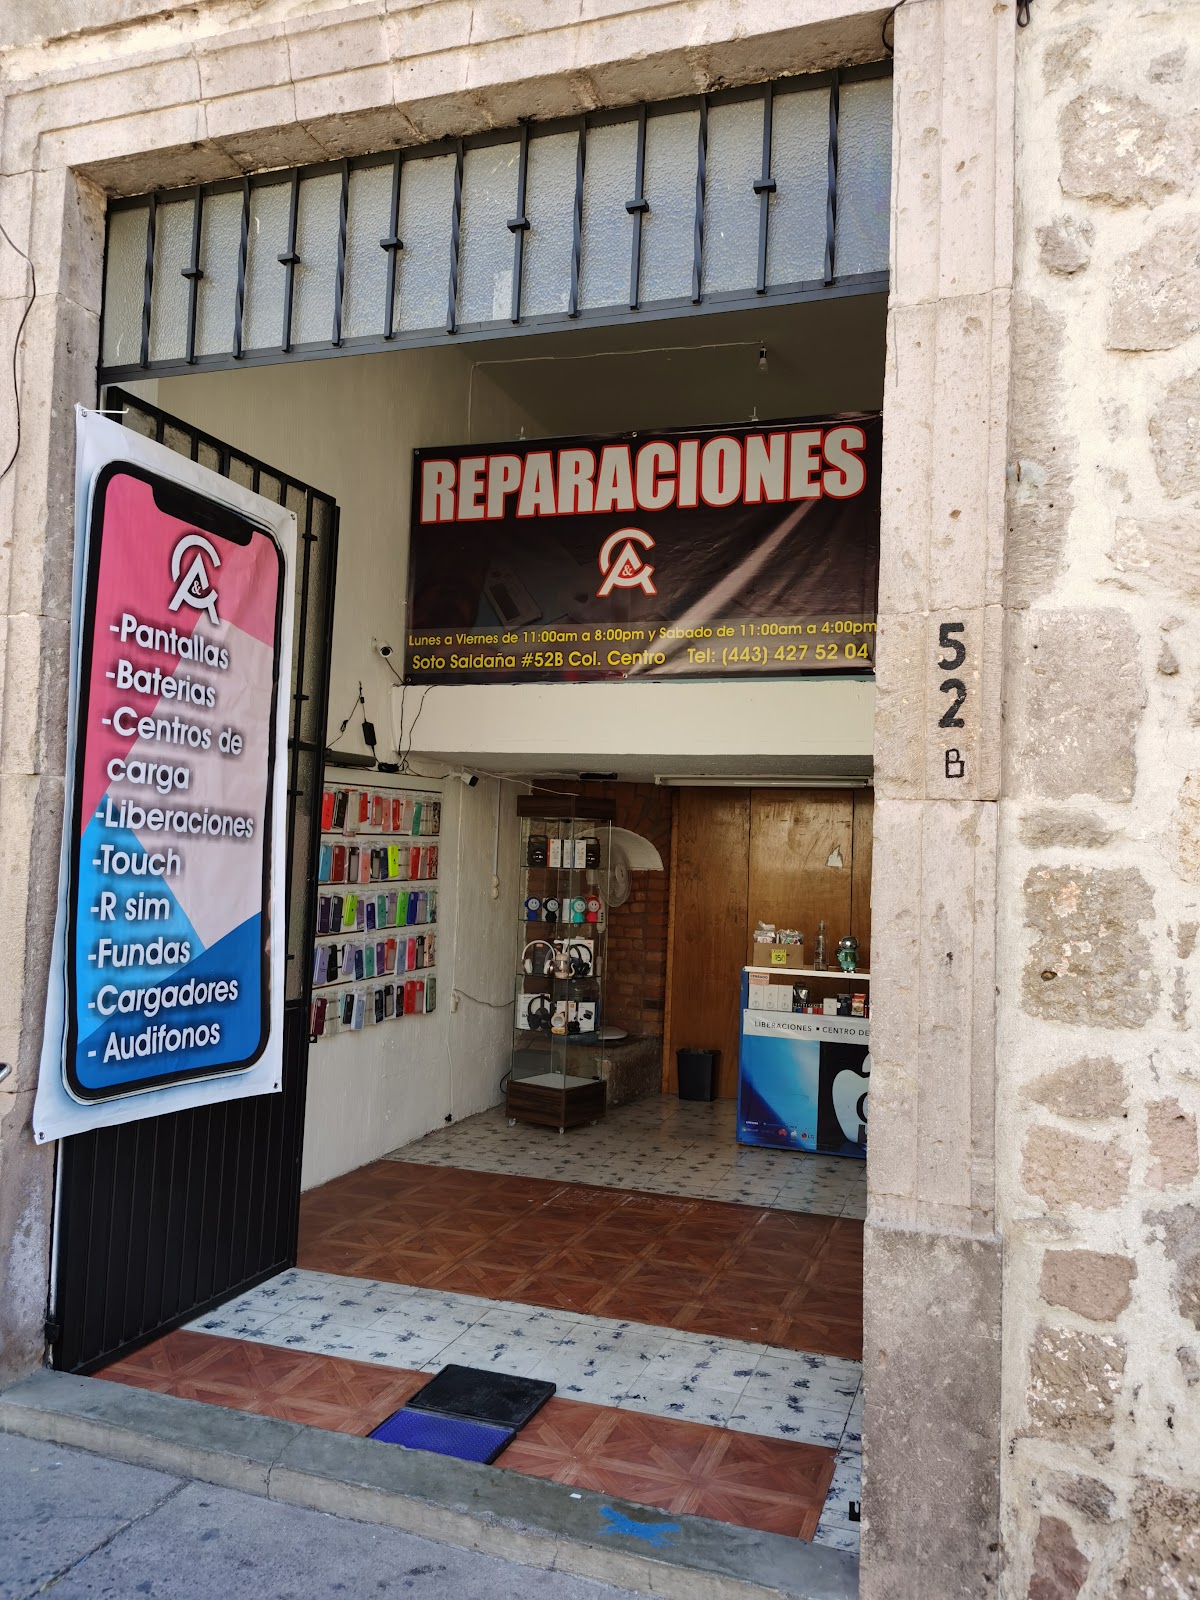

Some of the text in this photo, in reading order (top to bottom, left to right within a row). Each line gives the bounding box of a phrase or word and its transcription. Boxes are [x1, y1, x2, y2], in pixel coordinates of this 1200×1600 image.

[420, 426, 867, 525] REPARACIONES
[109, 612, 229, 669] -Pantallas
[408, 620, 877, 646] Lunes a Viernes de 11:00am a 8:00pm y Sabado de 11:00am a 4:00pm
[412, 642, 869, 670] Soto Saldaña #52B Col. Centro Tel: (443) 427 52 04
[105, 658, 216, 708] -Baterias
[101, 706, 243, 755] -Centros de
[107, 758, 190, 794] carga
[95, 797, 254, 838] -Liberaciones
[92, 844, 181, 876] -Touch
[124, 892, 170, 921] sim
[87, 936, 191, 969] -Fundas
[87, 977, 239, 1018] -Cargadores
[102, 1022, 221, 1064] Audifonos
[754, 1020, 870, 1037] LIBERACIONES CENTRO DE
